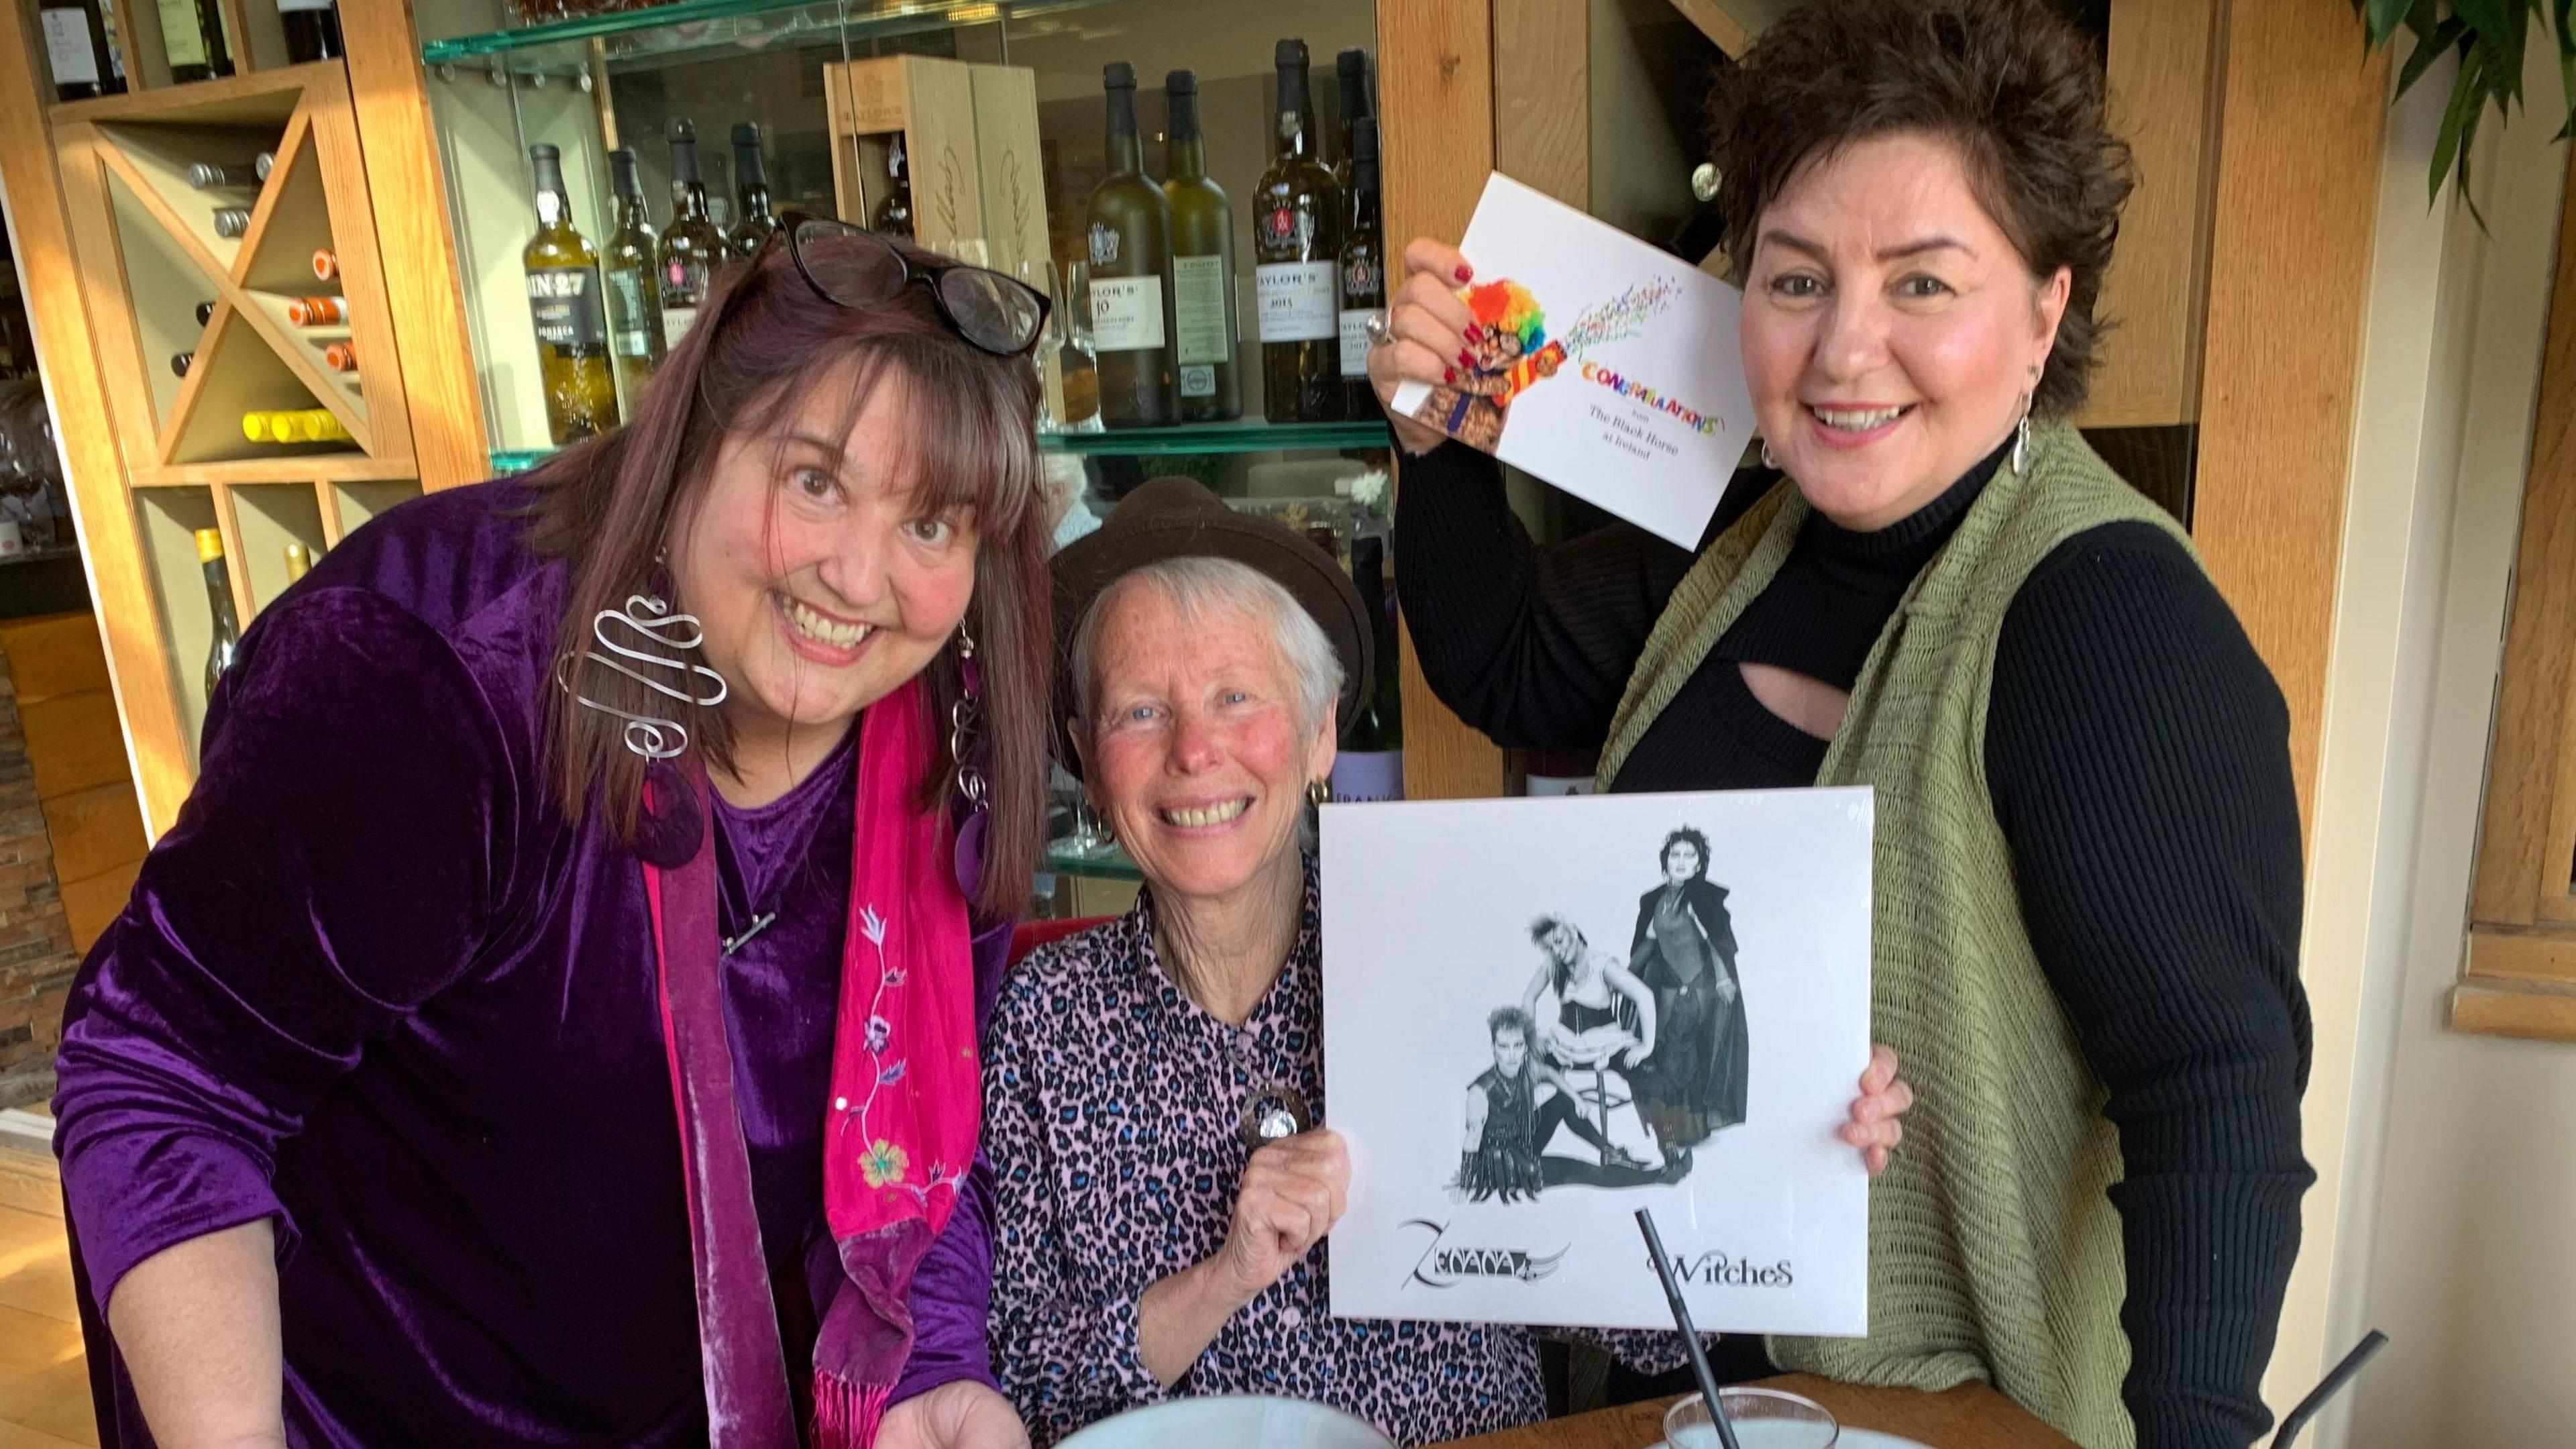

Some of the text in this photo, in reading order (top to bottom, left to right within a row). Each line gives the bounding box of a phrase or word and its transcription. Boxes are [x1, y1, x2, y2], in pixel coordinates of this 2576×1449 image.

[555, 272, 586, 297] 27
[1092, 285, 1134, 298] YLOR'S
[1590, 403, 1679, 457] The Black Horse
[1603, 431, 1651, 461] at Ireland
